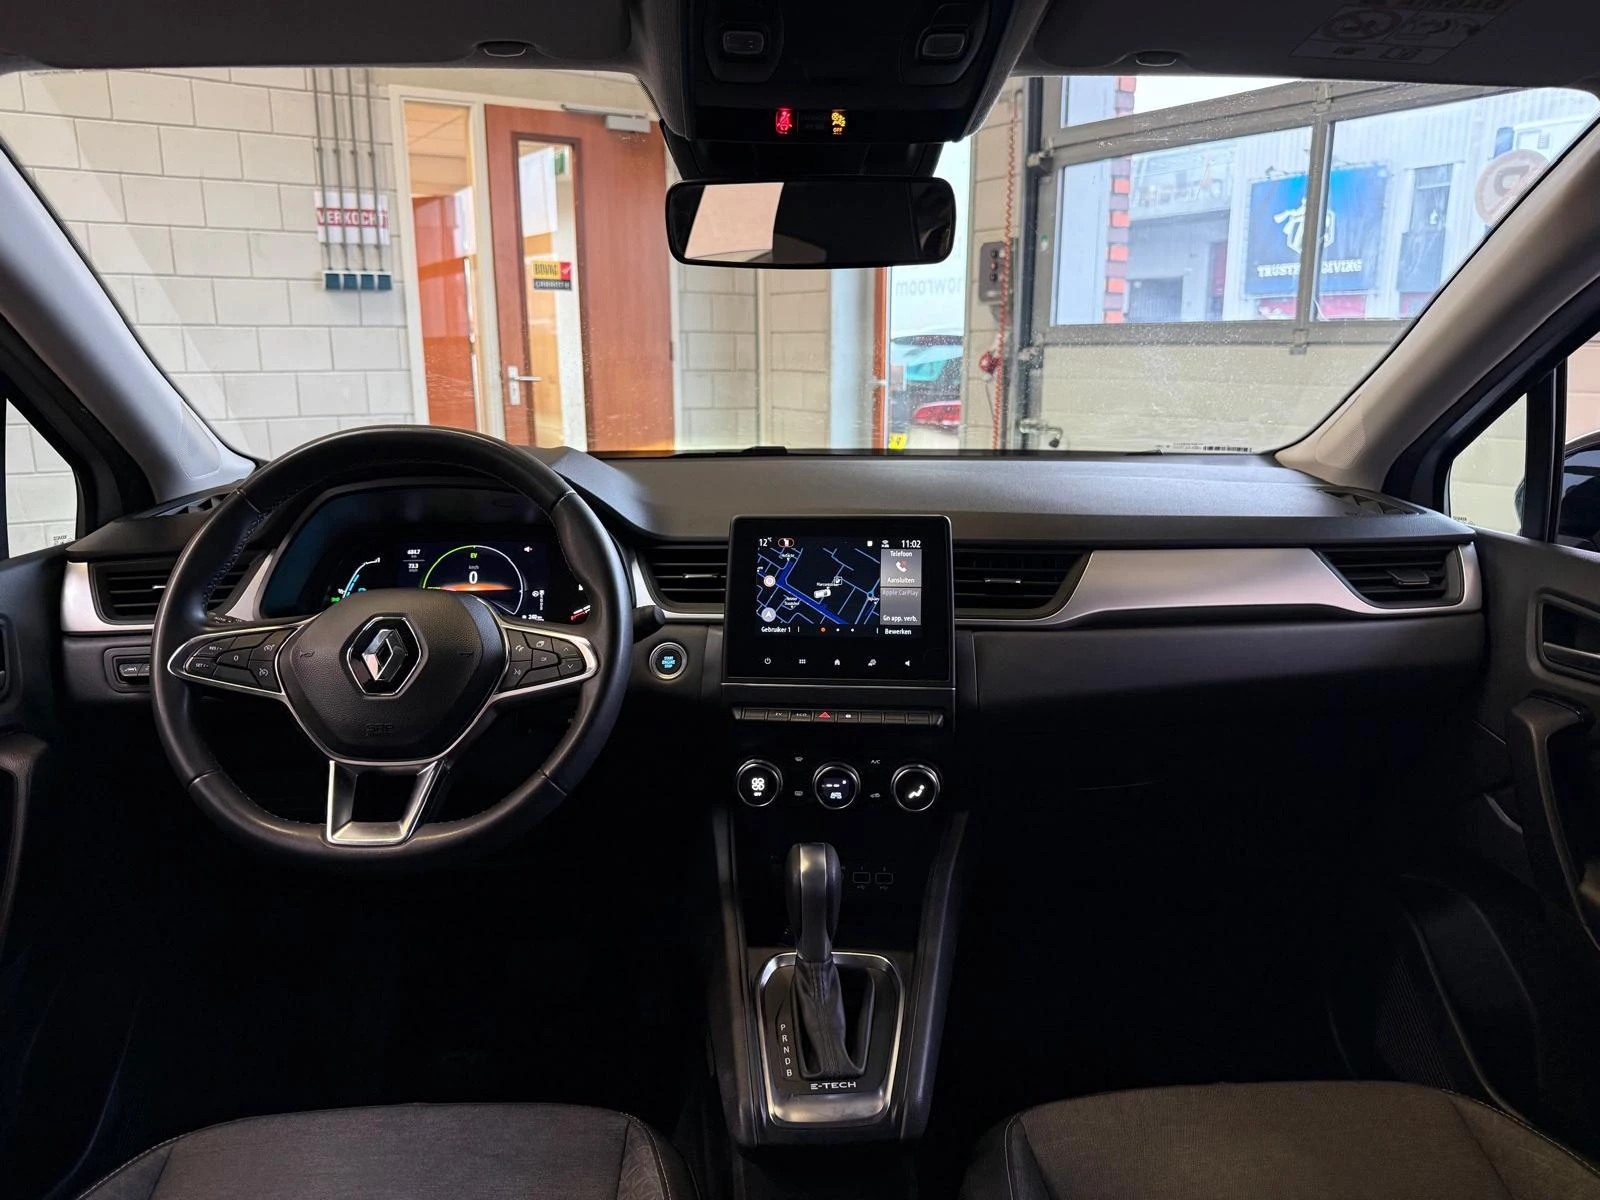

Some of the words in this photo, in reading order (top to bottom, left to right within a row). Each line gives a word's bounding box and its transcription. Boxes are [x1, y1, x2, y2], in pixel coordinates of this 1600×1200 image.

[901, 539, 922, 549] 11:02
[889, 550, 913, 558] Telefoon
[887, 576, 915, 584] Aansluiten
[903, 614, 919, 622] verb.
[884, 628, 912, 636] Bewerken
[782, 1034, 788, 1042] R
[783, 1046, 790, 1054] N
[786, 1069, 793, 1077] B
[810, 1081, 857, 1090] E-TECH
